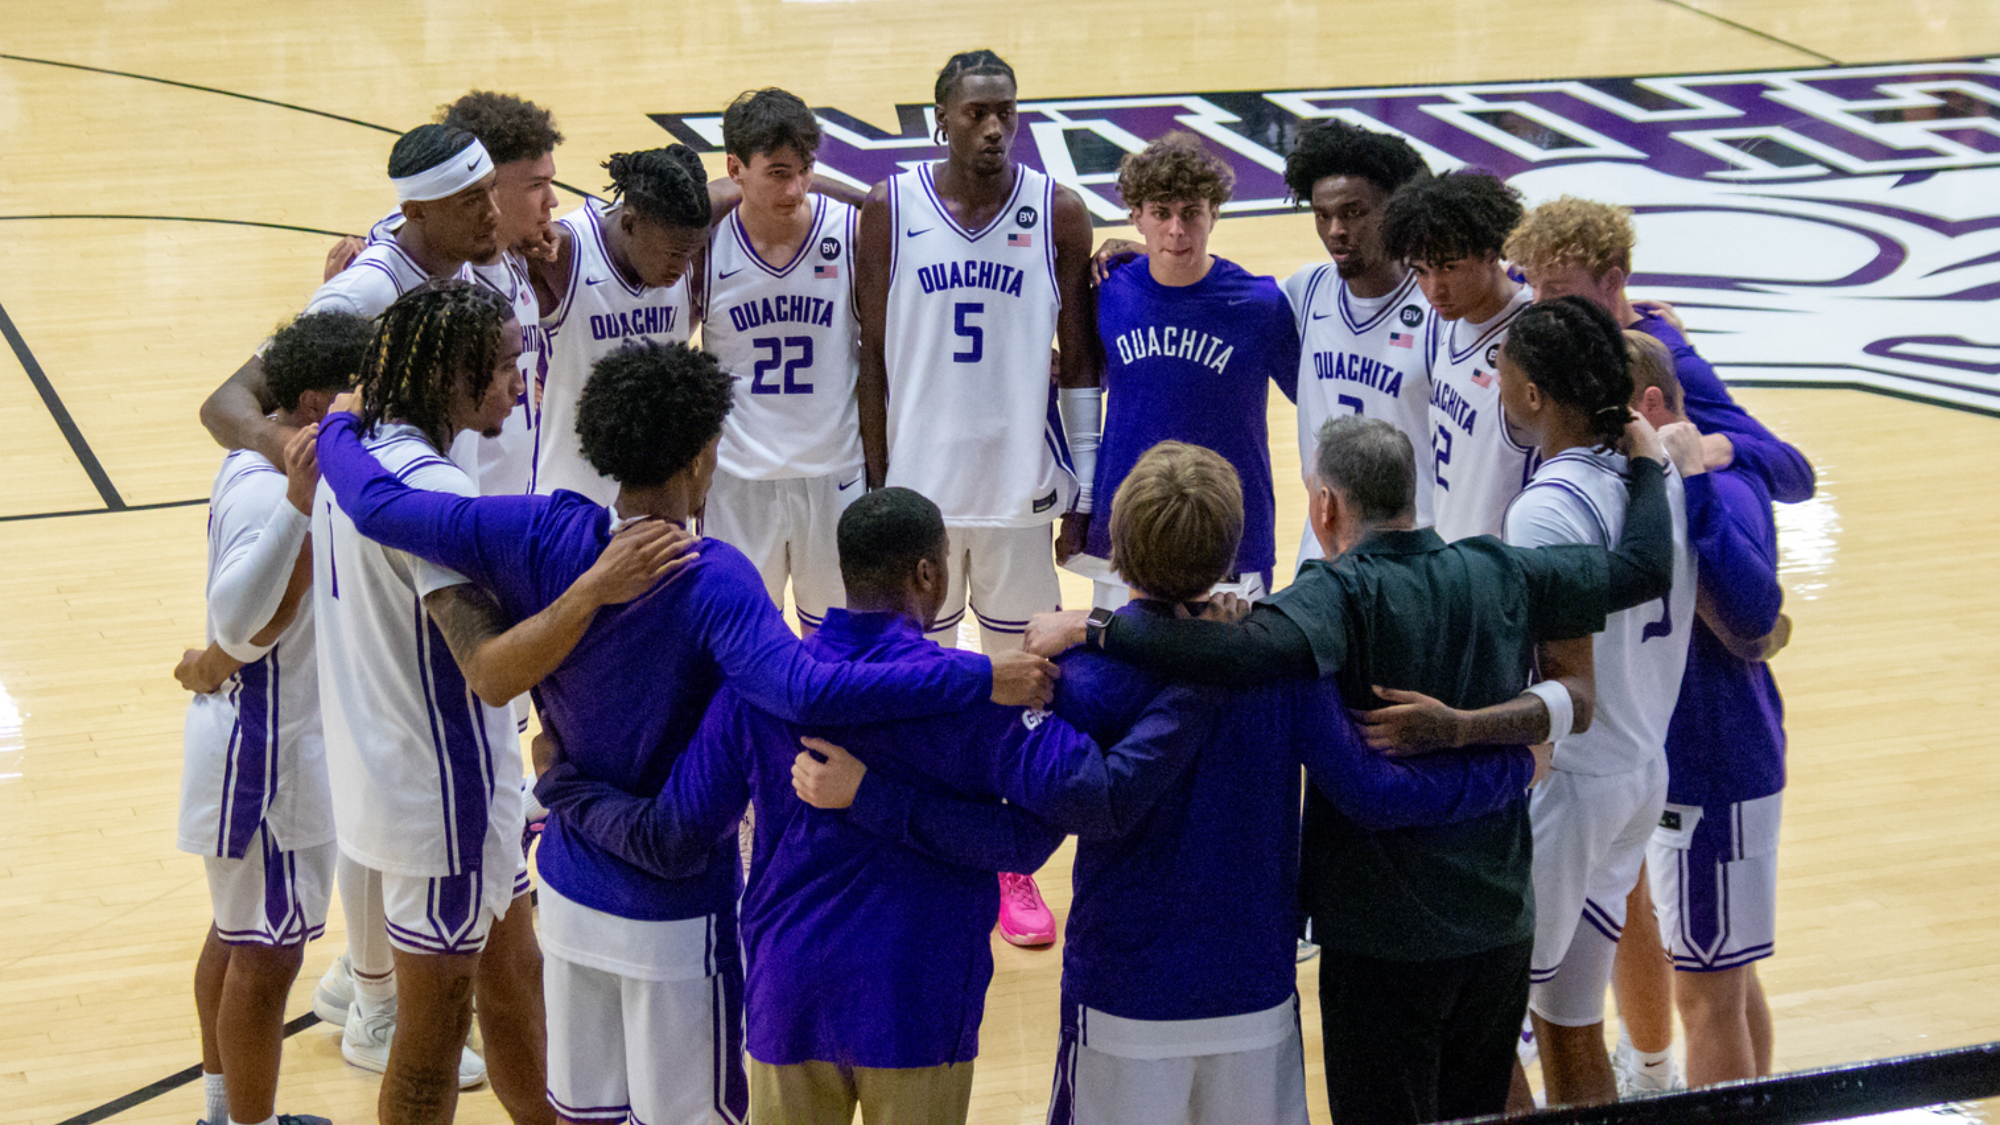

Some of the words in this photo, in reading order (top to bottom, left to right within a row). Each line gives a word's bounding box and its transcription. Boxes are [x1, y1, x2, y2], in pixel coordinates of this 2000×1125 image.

[1019, 211, 1035, 223] BV
[822, 242, 838, 255] BV
[918, 260, 1023, 297] OUACHITA
[729, 295, 834, 332] OUACHITA
[1402, 309, 1421, 322] BV
[953, 303, 985, 364] 5
[1116, 326, 1234, 375] OUACHITA
[750, 336, 814, 395] 22
[1313, 351, 1404, 399] OUACHITA
